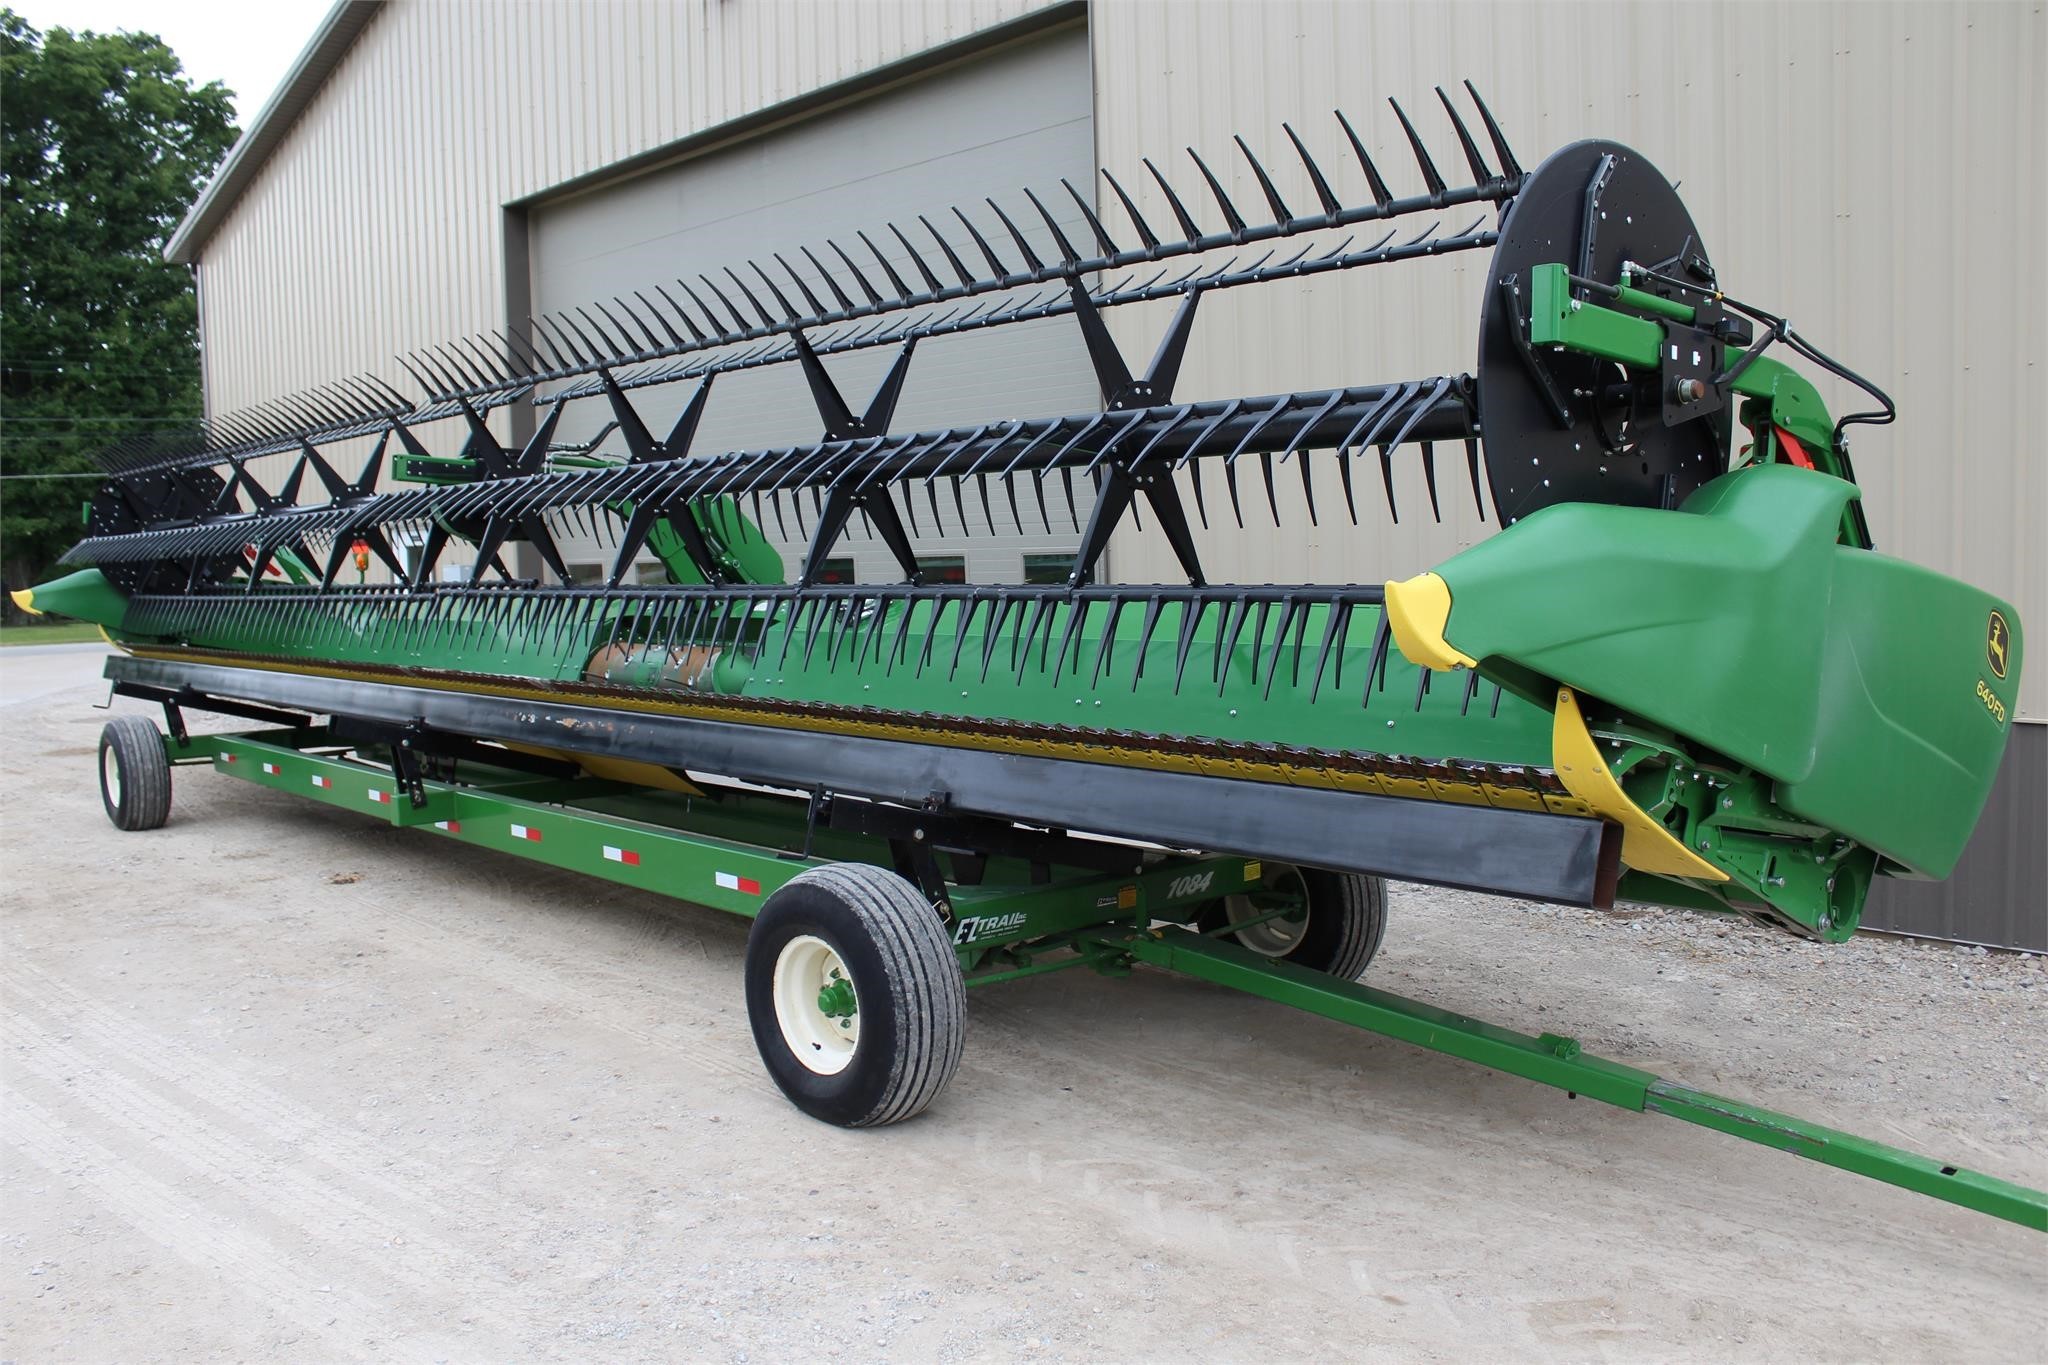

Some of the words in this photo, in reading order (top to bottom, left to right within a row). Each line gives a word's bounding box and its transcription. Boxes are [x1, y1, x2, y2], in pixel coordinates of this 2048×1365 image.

[1976, 680, 2004, 722] 640FD
[1167, 871, 1214, 899] 1084
[978, 912, 1025, 932] TRAIL
